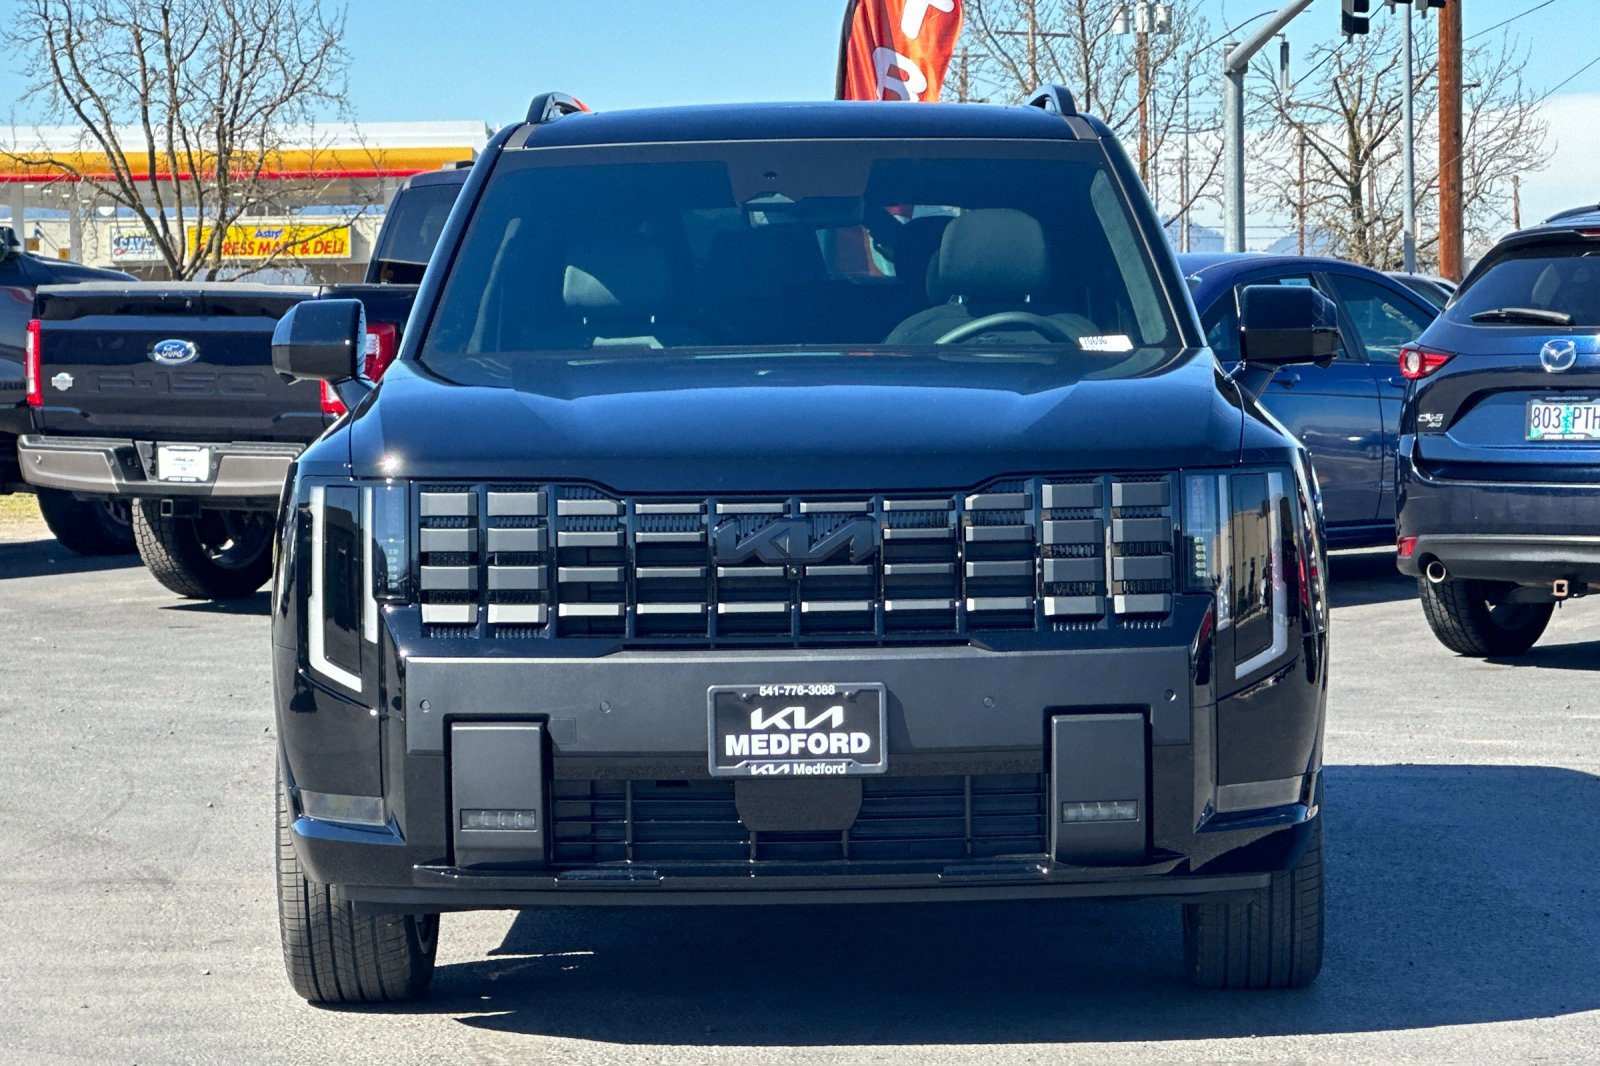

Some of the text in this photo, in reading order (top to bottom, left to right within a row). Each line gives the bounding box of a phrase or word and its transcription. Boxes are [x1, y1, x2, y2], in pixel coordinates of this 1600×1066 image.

[300, 241, 310, 255] &
[313, 240, 344, 255] DELI
[1532, 406, 1562, 429] 803
[759, 684, 836, 697] 541-776-3088
[750, 705, 844, 730] KIA
[725, 732, 871, 756] MEDFORD
[750, 762, 847, 775] KIA Medford
